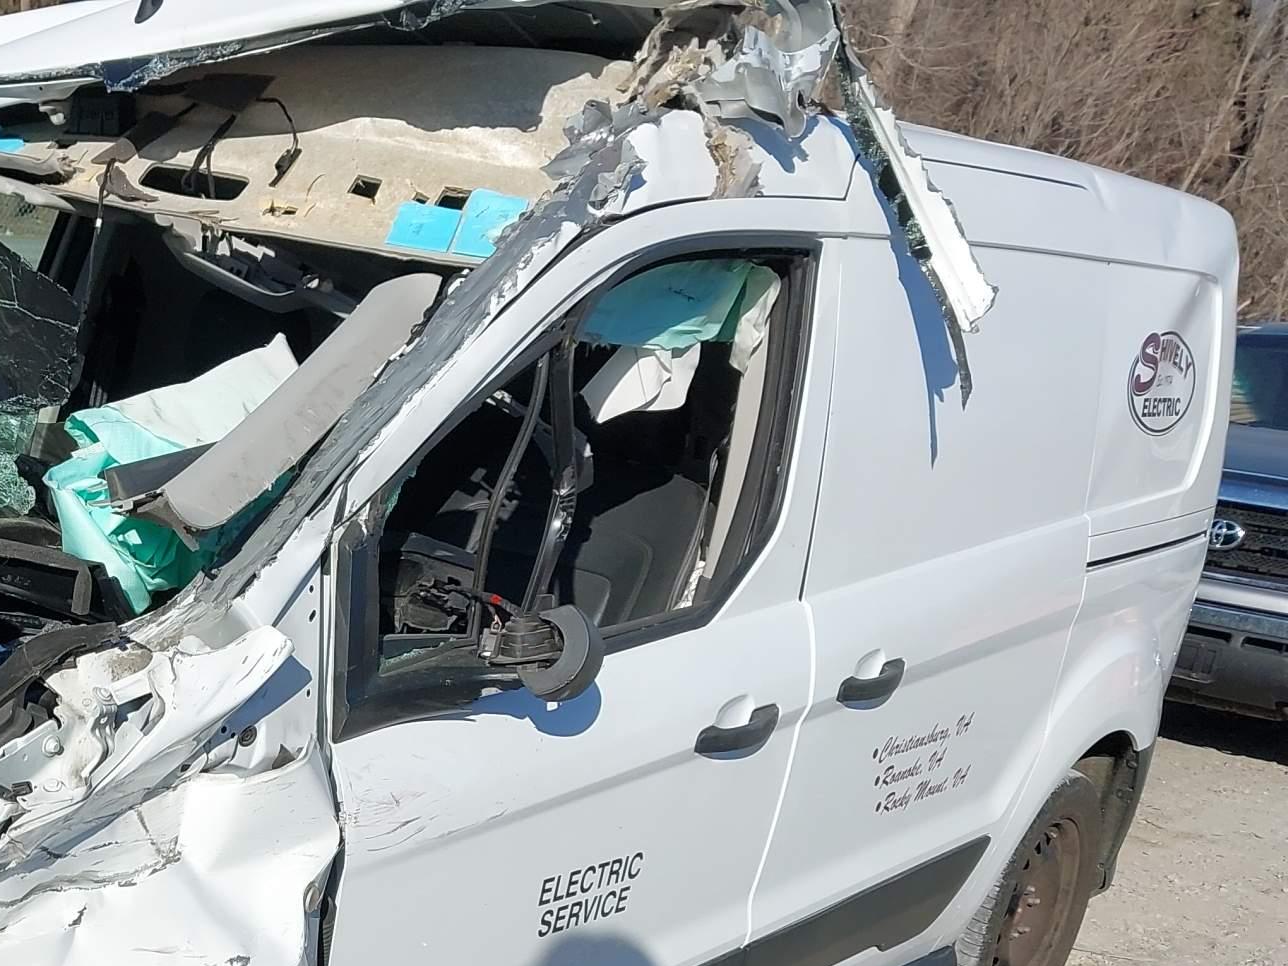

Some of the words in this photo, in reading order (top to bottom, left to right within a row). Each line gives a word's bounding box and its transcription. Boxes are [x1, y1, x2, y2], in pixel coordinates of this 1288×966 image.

[1131, 332, 1193, 396] SHIVELY
[1141, 397, 1181, 417] ELECTRIC
[879, 723, 951, 763] Christiansburg,
[956, 712, 975, 736] VA
[880, 757, 922, 789] Roanoke,
[928, 747, 947, 771] VA
[881, 788, 911, 815] Rocky
[952, 764, 971, 788] VA
[538, 852, 644, 906] ELECTRIC
[538, 886, 631, 938] SERVICE
